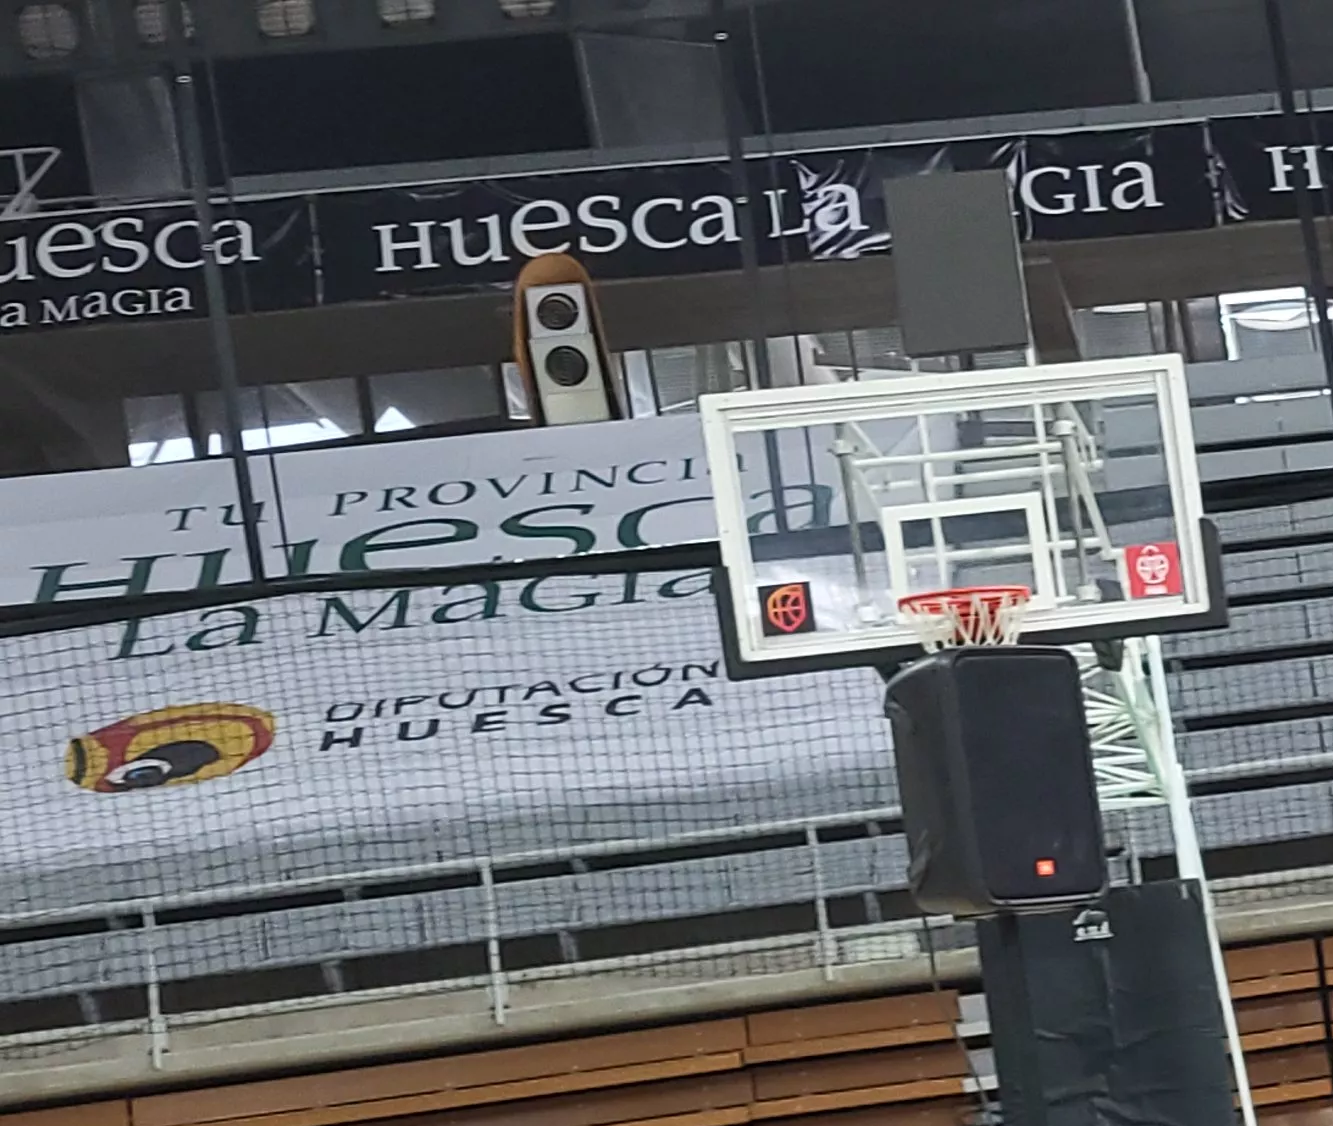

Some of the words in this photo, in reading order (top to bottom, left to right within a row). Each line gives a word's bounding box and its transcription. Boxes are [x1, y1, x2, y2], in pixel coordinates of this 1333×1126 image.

[0, 216, 262, 284] uesca
[0, 300, 30, 327] a
[318, 688, 714, 751] HUESCA
